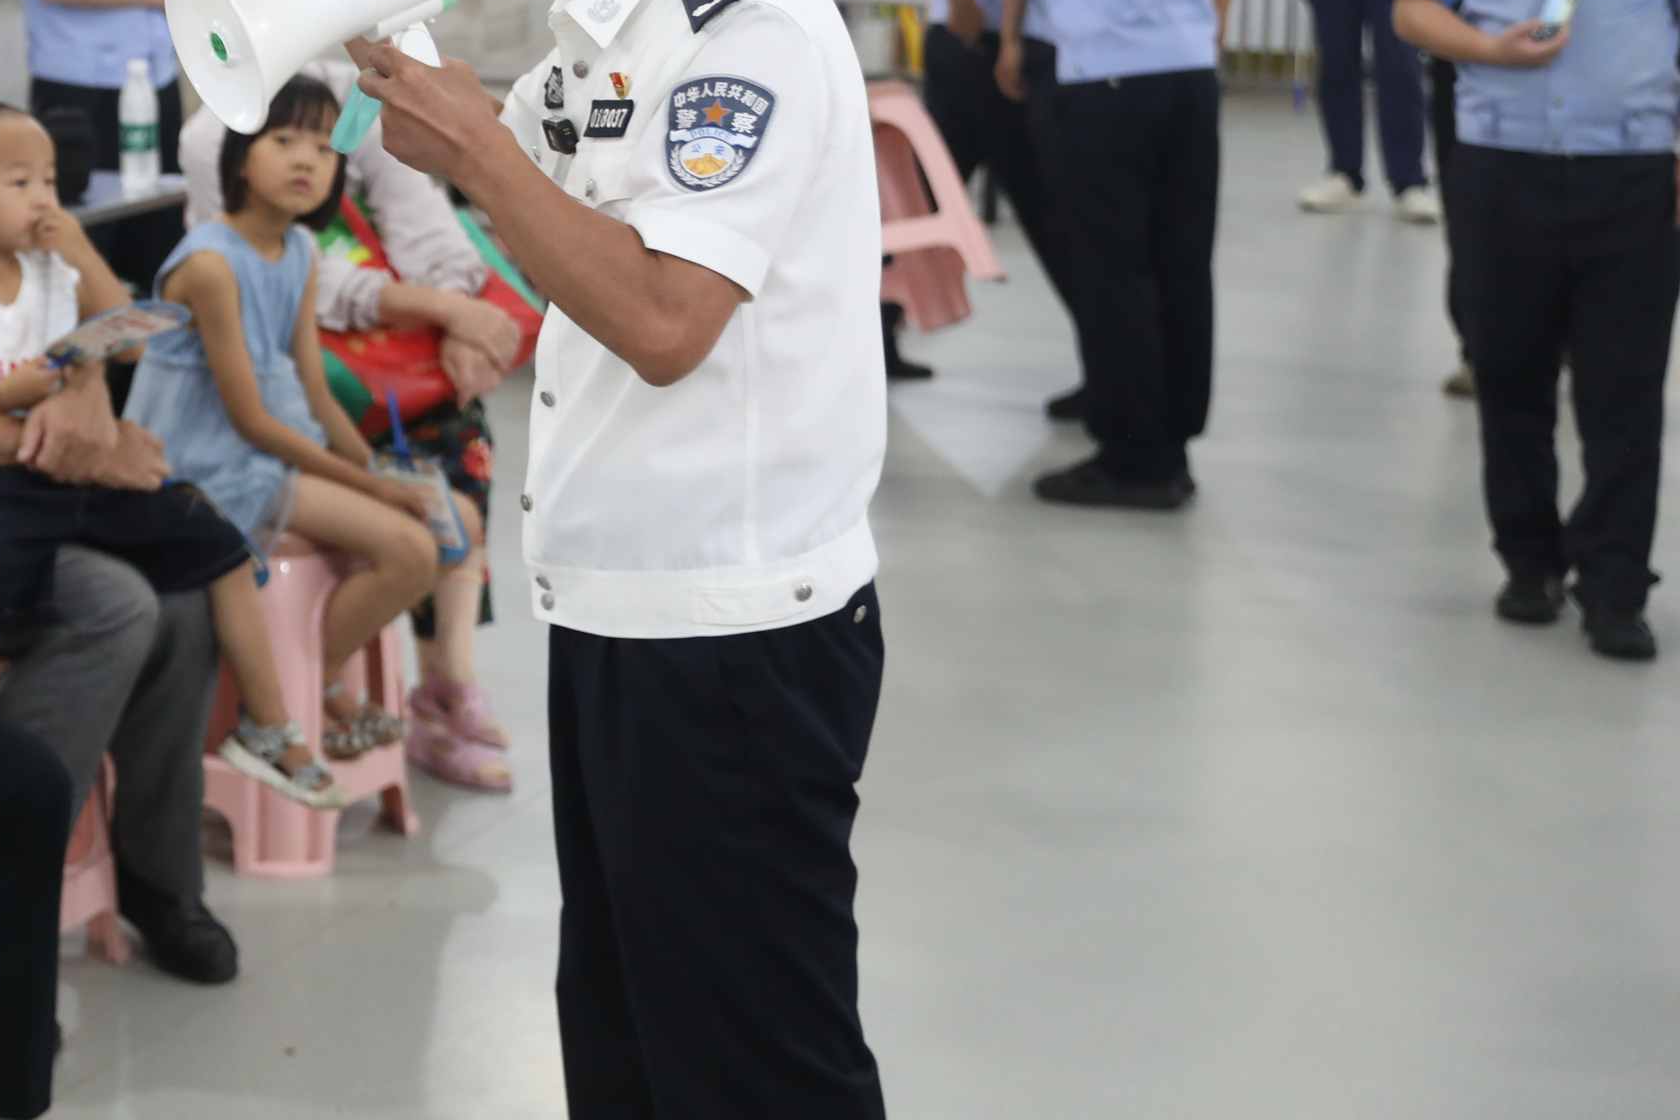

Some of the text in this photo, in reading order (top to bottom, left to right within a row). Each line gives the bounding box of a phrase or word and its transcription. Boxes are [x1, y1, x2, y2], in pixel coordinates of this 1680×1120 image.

[673, 81, 769, 115] 中华人民共和国
